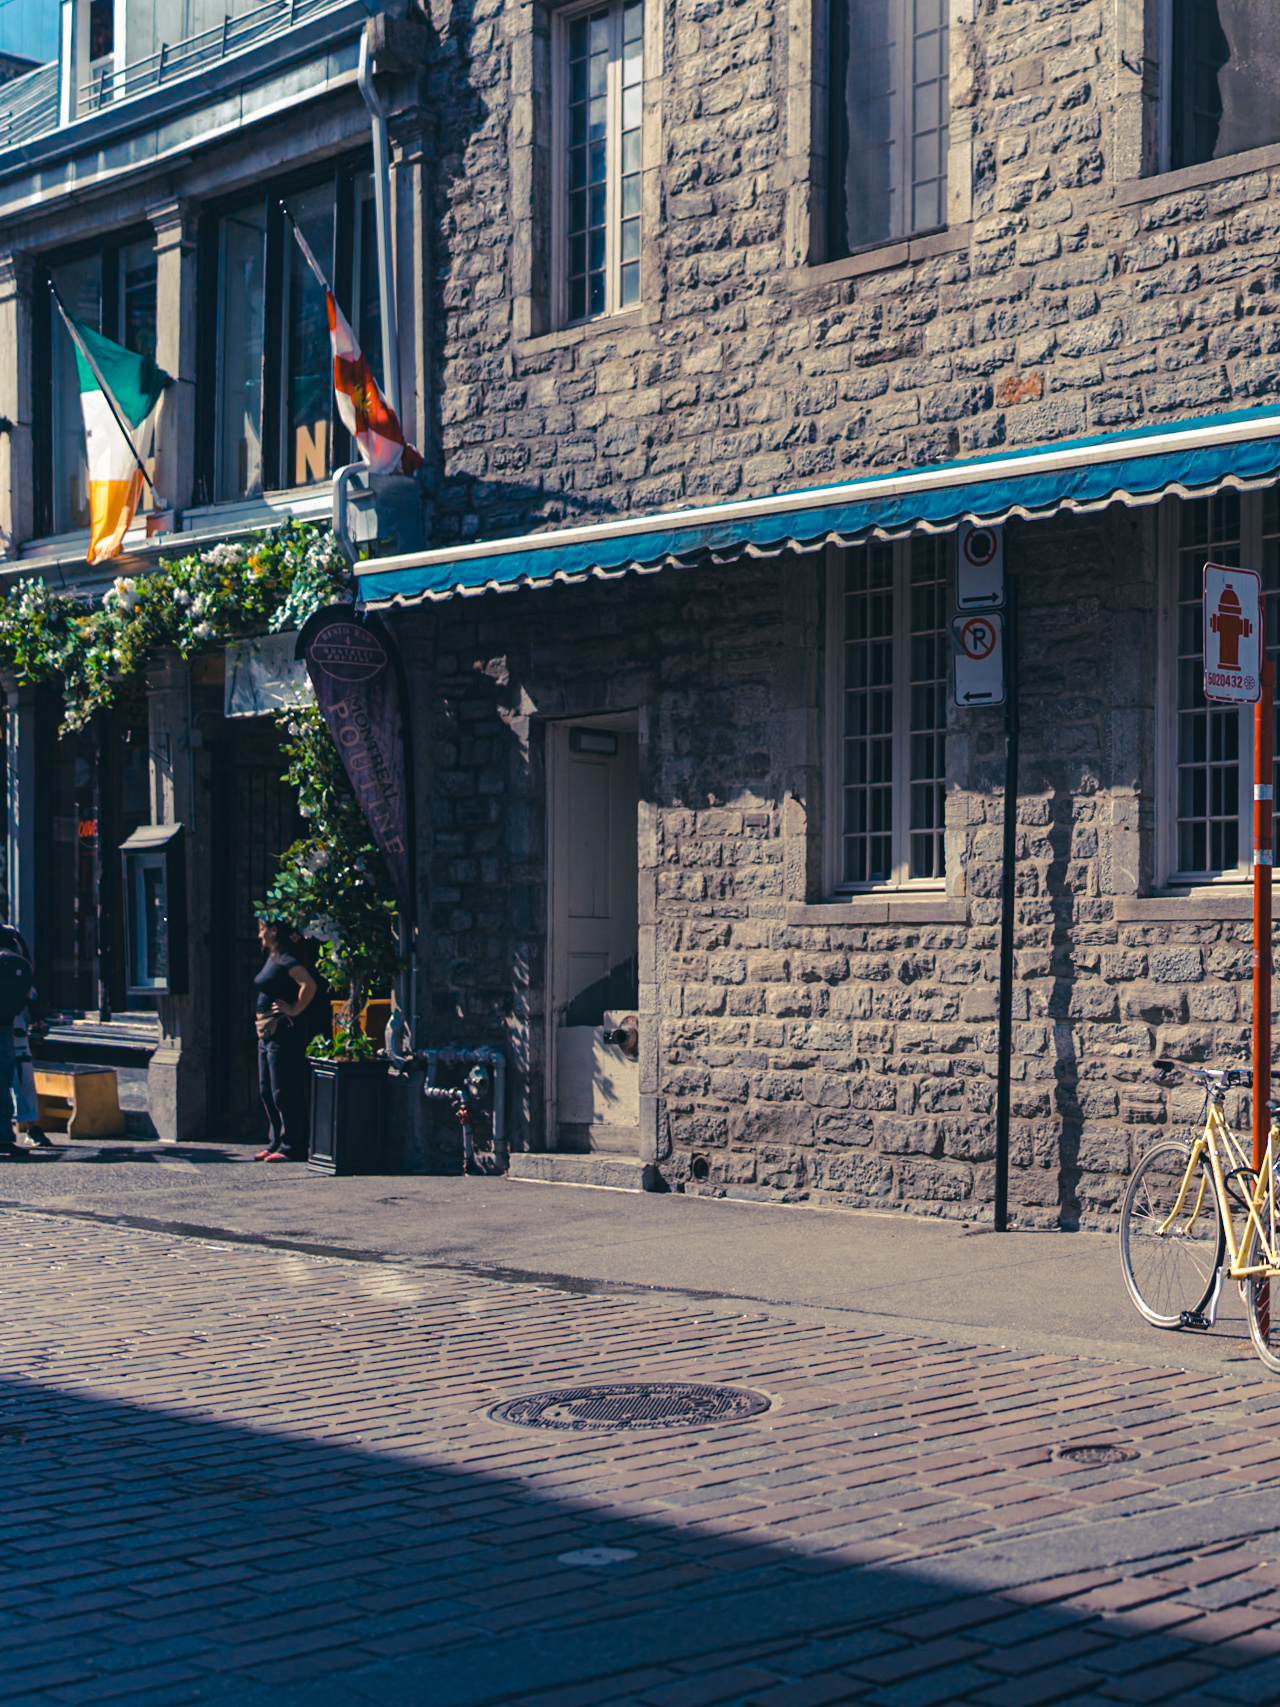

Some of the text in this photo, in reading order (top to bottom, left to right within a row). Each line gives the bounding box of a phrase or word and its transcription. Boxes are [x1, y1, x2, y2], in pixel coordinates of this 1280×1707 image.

[295, 419, 326, 485] N
[1208, 672, 1243, 688] 5020432
[328, 700, 404, 853] POUTINE
[350, 694, 398, 805] MONTREAL
